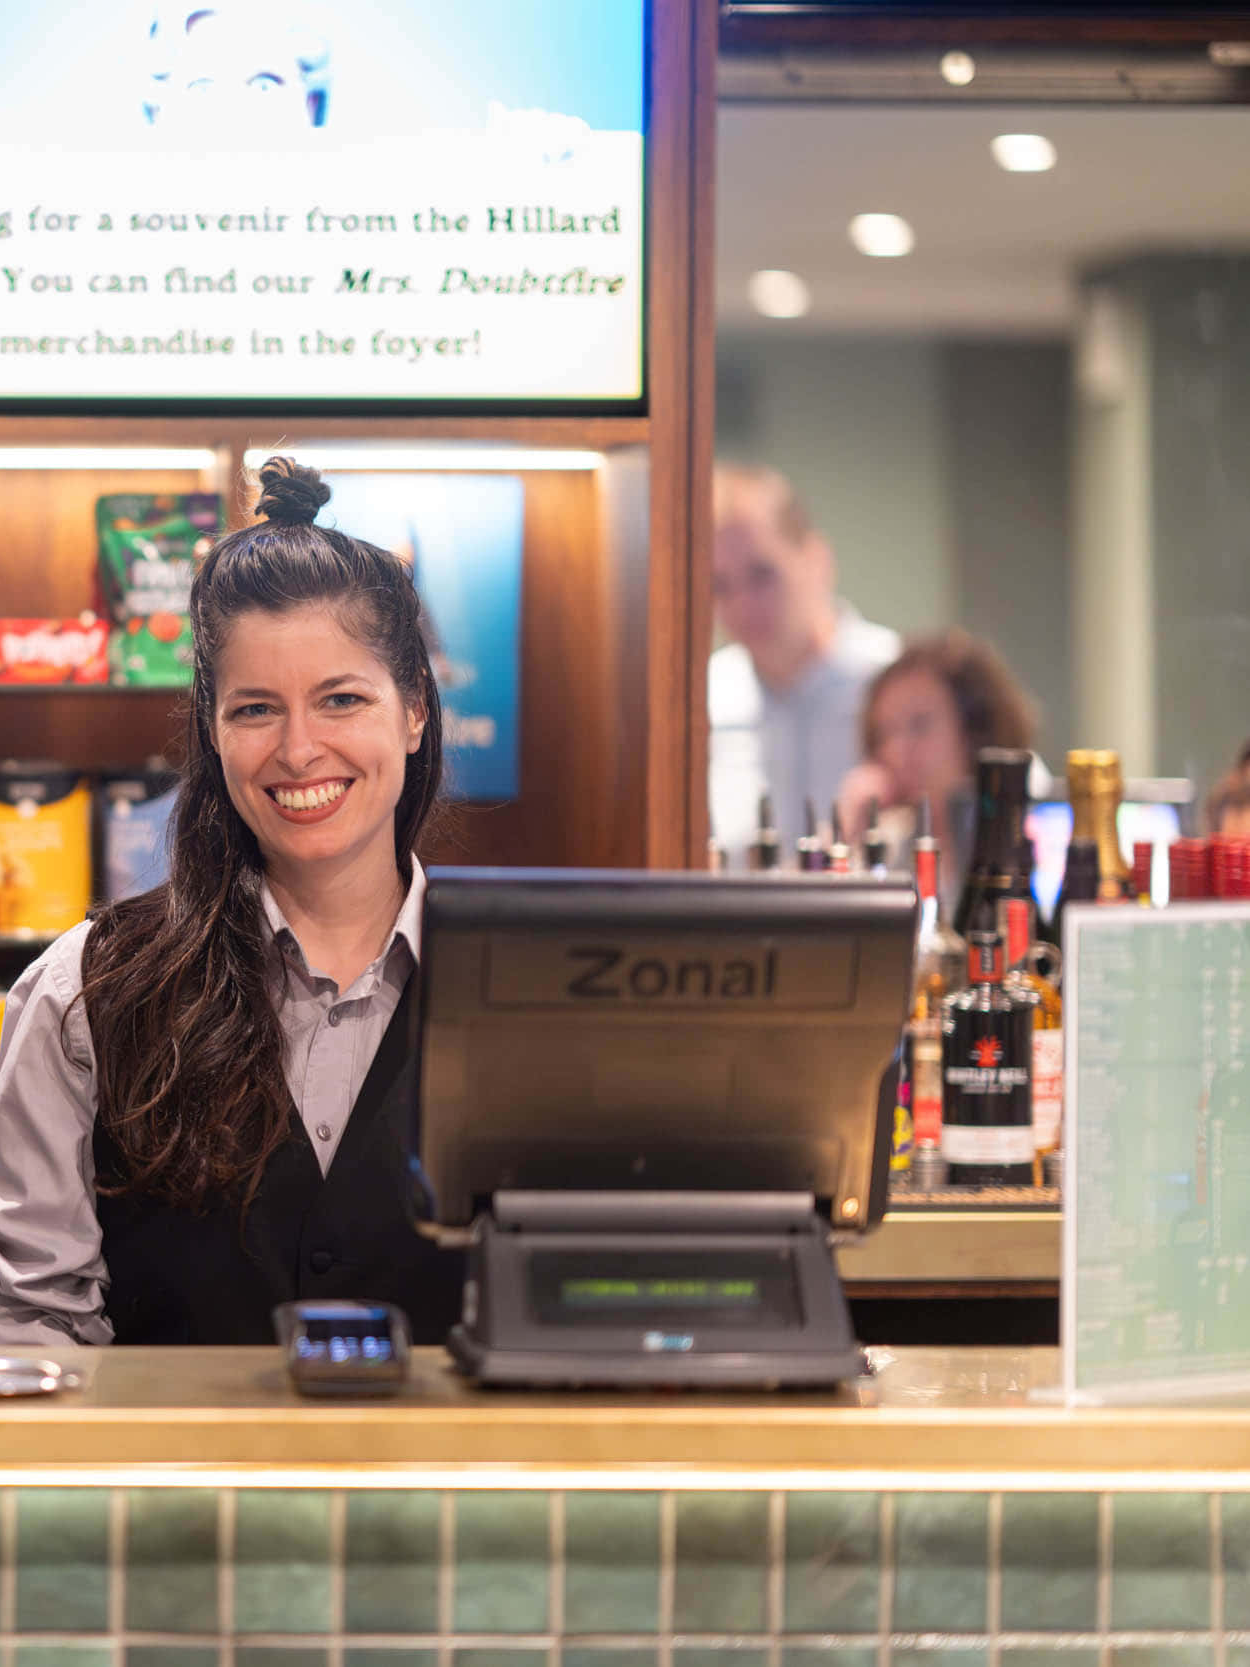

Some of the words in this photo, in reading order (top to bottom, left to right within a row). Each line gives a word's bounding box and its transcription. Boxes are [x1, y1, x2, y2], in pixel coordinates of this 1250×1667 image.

[27, 204, 81, 233] for
[96, 212, 114, 233] a
[129, 206, 289, 233] souvenir
[305, 206, 398, 234] from
[412, 206, 471, 234] the
[485, 205, 623, 235] Hillard
[0, 266, 74, 294] You
[87, 273, 149, 294] can
[164, 266, 238, 294] find
[251, 273, 314, 294] our
[0, 329, 235, 355] merchandise
[250, 330, 284, 356] in
[298, 329, 356, 356] the
[370, 328, 481, 364] foyer!
[564, 946, 779, 998] Zonal
